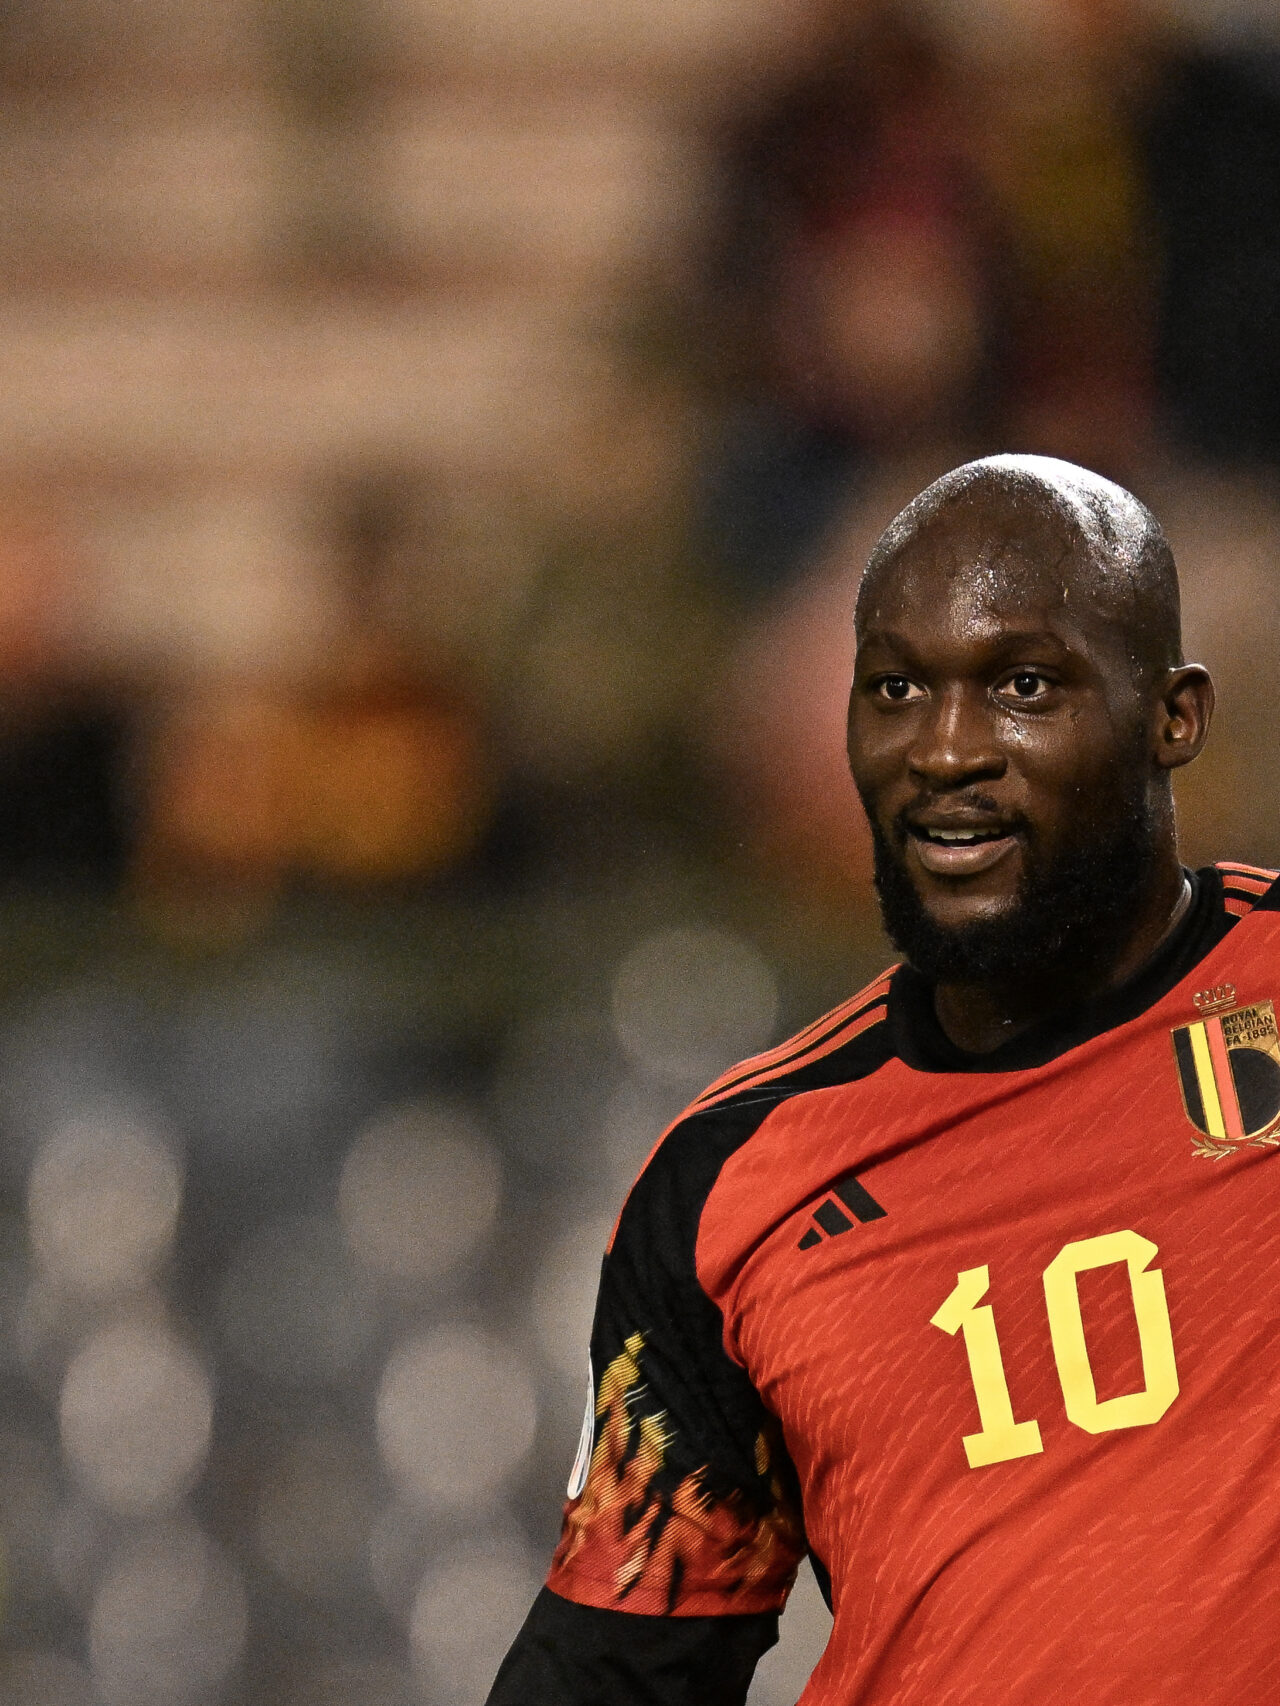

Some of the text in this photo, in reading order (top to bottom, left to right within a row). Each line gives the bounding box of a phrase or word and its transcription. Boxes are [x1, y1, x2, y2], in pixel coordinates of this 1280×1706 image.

[1222, 1008, 1257, 1025] ROYAL
[1224, 1015, 1273, 1035] BELGIAN
[930, 1229, 1180, 1469] 10
